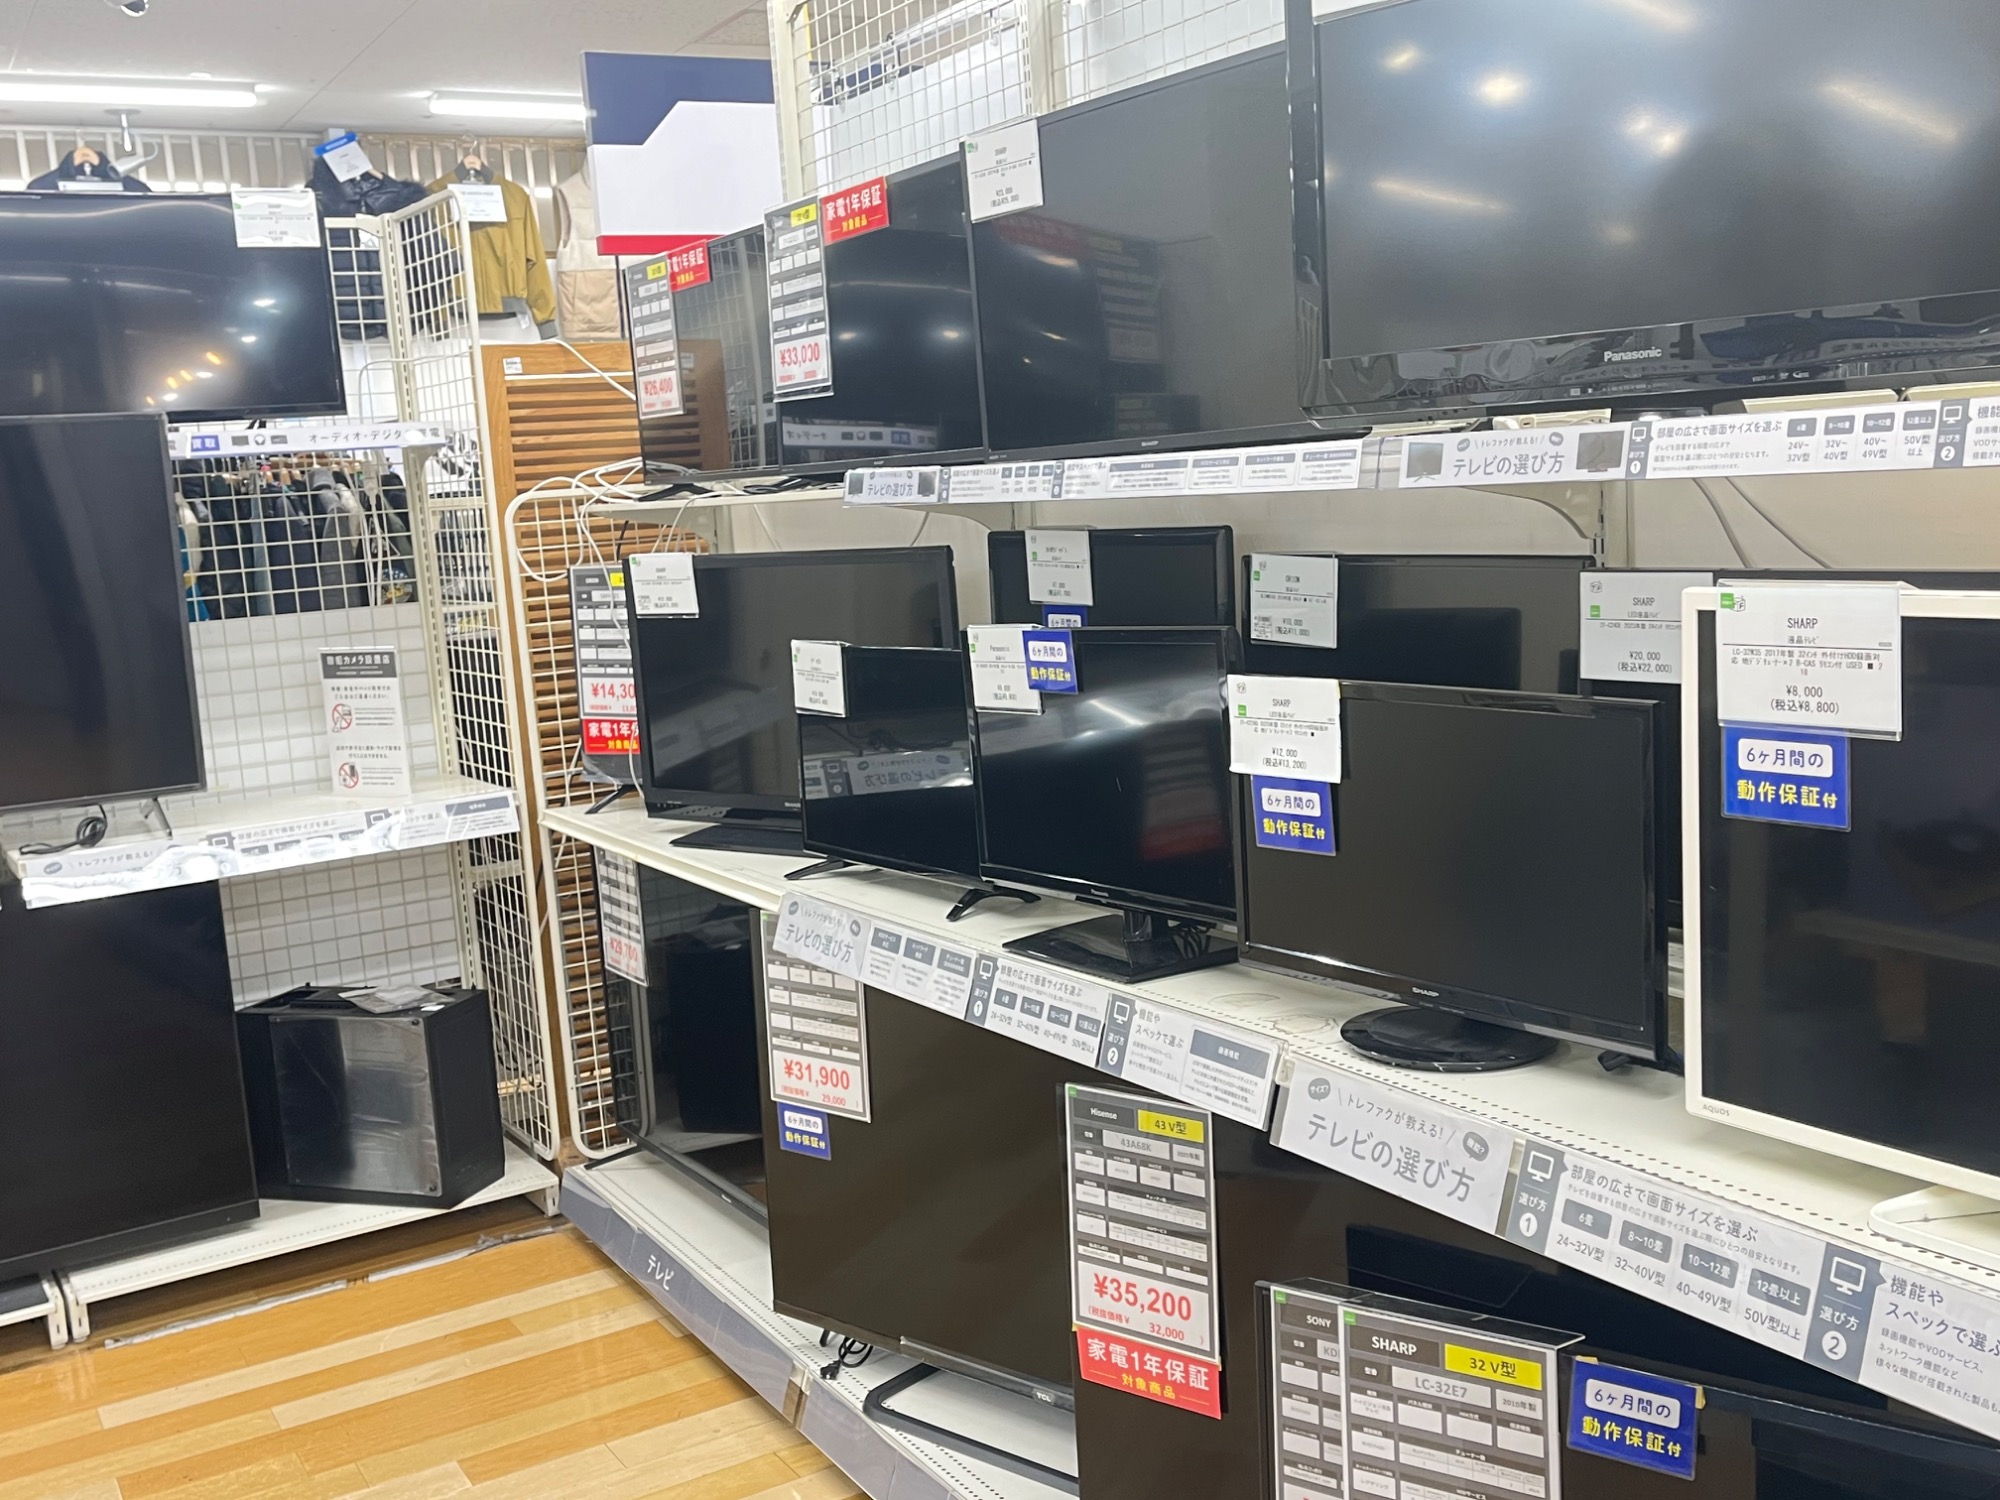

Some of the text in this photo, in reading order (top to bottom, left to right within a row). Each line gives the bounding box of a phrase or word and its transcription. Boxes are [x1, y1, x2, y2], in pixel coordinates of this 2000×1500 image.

[826, 184, 881, 221] 家電1年保証
[1604, 347, 1662, 362] Panasonic
[1657, 420, 1782, 438] 部屋の広さで画面サイズを選ぶ
[1904, 434, 1931, 445] 50V型
[1787, 453, 1810, 462] 32V型
[1824, 451, 1847, 460] 40V型
[1862, 449, 1887, 459] 49V型
[1453, 452, 1565, 477] テレビの選び方
[867, 483, 913, 497] テレビの選び方
[1633, 597, 1655, 606] SHARP
[1787, 618, 1818, 629] SHARP
[1032, 646, 1063, 657] 6ヶ月間の
[1629, 651, 1661, 661] ¥20,000
[1764, 649, 1795, 658] 2017年製
[1618, 661, 1672, 673] (税込¥22,000)
[1846, 662, 1863, 670] USED
[1031, 667, 1071, 682] 動作保証付
[1786, 685, 1823, 698] ¥8,000
[1272, 699, 1291, 707] SHARP
[1770, 699, 1839, 715] (税込¥8,800)
[1272, 748, 1298, 758] ¥12,000
[1747, 747, 1823, 768] 6ヶ月間の
[1263, 758, 1307, 770] (税込¥13,200)
[1737, 779, 1837, 809] 動作保証付
[1267, 795, 1315, 810] 6ヶ月間の
[1263, 818, 1325, 840] 動作保証付
[786, 924, 854, 963] テレビの選び方
[1412, 987, 1439, 997] SHARP
[1139, 1009, 1160, 1024] 機能や
[1107, 1033, 1125, 1046] 選び方
[1135, 1024, 1184, 1049] スペックで選ぶ
[784, 1057, 850, 1090] ¥31,900
[1090, 1107, 1118, 1120] Hisense
[1348, 1093, 1444, 1140] トレファクが教える!
[1703, 1104, 1730, 1116] AQUOS
[787, 1115, 819, 1130] 6ヶ月間の
[1155, 1119, 1187, 1135] 43 V型
[785, 1131, 826, 1149] 動作保証付
[1121, 1138, 1152, 1152] 43A68K
[1308, 1113, 1475, 1202] テレビの選び方
[1518, 1192, 1548, 1212] 選び方
[1570, 1164, 1759, 1243] 部屋の広さで画面サイズを選ぶ
[1578, 1212, 1594, 1227] 6畳
[647, 1254, 674, 1291] テレビ
[1093, 1272, 1192, 1321] ¥35,200
[1756, 1278, 1801, 1306] 12畳以上
[1890, 1274, 1944, 1308] 機能や
[1306, 1314, 1332, 1329] SONY
[1744, 1307, 1801, 1342] 50V型以上
[1819, 1305, 1860, 1332] 選び方
[1149, 1322, 1185, 1341] 32,000
[1323, 1345, 1340, 1358] KD
[1371, 1336, 1418, 1357] SHARP
[1881, 1327, 1984, 1374] 録画機能やVODサービス、
[1087, 1338, 1210, 1391] 家電1年保証
[1469, 1357, 1516, 1380] 32 V型
[1878, 1342, 1959, 1380] ネットワーク機能など
[1121, 1373, 1176, 1399] 対象商品
[1414, 1376, 1538, 1413] LC-32E7 2010年製
[1594, 1389, 1671, 1418] 6ヶ月間の
[1582, 1416, 1682, 1457] 動作保証付
